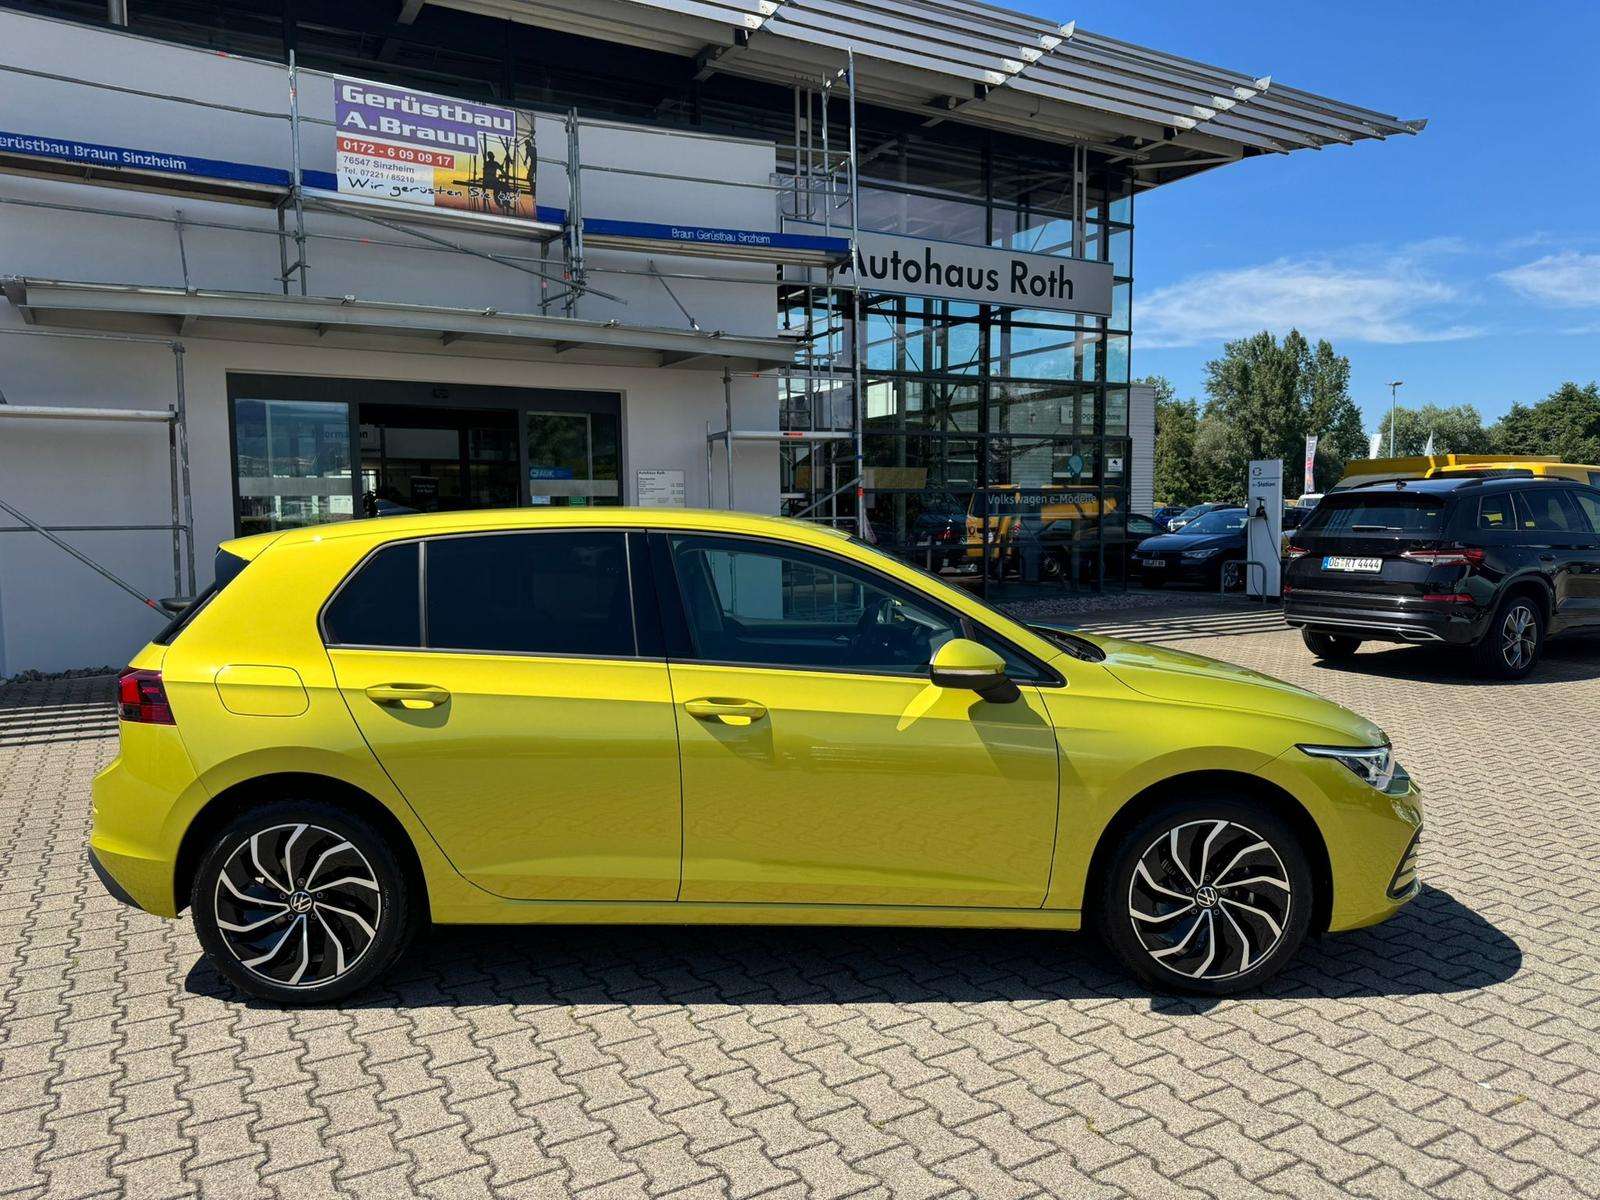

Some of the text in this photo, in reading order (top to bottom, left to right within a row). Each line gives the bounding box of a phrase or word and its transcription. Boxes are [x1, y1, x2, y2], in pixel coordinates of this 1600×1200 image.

[342, 85, 512, 131] Gerüstbau
[342, 111, 476, 148] A.Braun
[0, 136, 187, 170] erüstbau Braun Sinzheim
[343, 140, 375, 154] 0172
[387, 148, 395, 157] 6
[399, 149, 414, 160] 09
[418, 153, 432, 162] 09
[436, 156, 451, 166] 17
[343, 155, 415, 173] 76547 Sinzheim
[360, 169, 384, 179] 07221
[348, 176, 384, 189] Wir
[389, 185, 463, 197] gerüsten
[470, 187, 491, 199] Sie
[671, 228, 771, 244] Braun Gerüstbau Sinzheim
[838, 246, 1074, 300] Autohaus Roth
